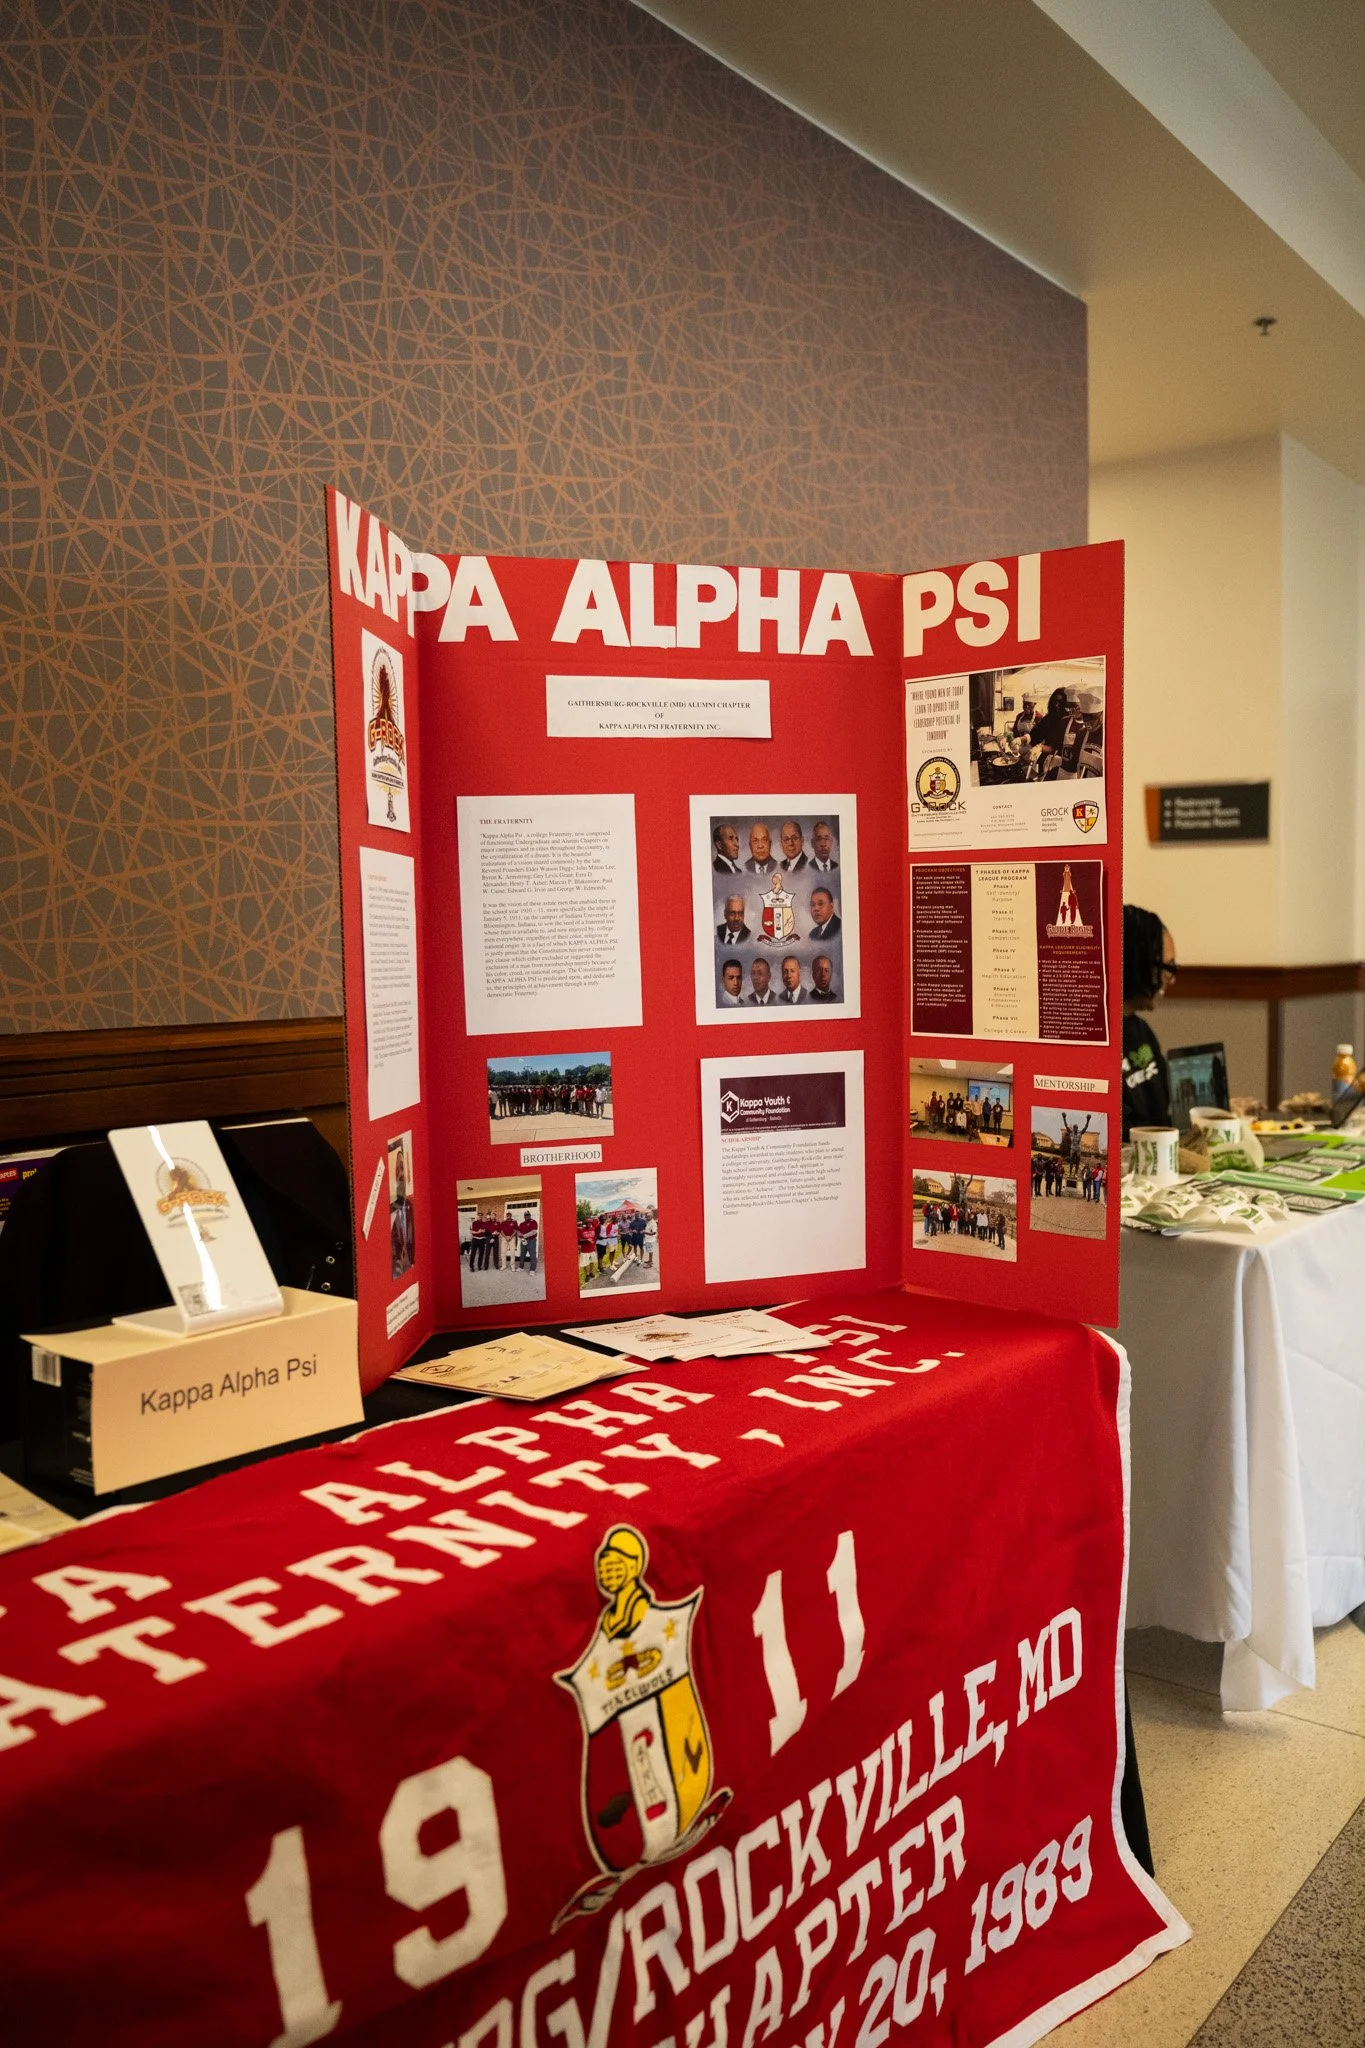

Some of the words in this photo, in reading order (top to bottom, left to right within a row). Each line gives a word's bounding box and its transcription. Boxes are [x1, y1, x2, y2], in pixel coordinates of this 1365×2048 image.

[335, 489, 519, 642] KAPPA
[552, 558, 875, 657] ALPHA
[903, 553, 1040, 657] PSI
[568, 700, 669, 708] GAITHERSBURG-ROCKVILLE
[670, 701, 687, 709] (MD)
[1040, 807, 1069, 817] GROCK
[1035, 1079, 1096, 1091] MENTORSHIP
[727, 1101, 734, 1113] K
[740, 1099, 763, 1110] Kappa
[764, 1097, 785, 1107] Youth
[740, 1108, 765, 1117] Community
[765, 1107, 791, 1115] Foundation
[523, 1151, 601, 1164] BROTHERHOOD
[141, 1382, 213, 1416] Kappa
[219, 1367, 279, 1398] Alpha
[287, 1353, 317, 1382] Psi
[750, 1346, 966, 1412] INC.
[301, 1380, 716, 1527] ALPHA
[1017, 1607, 1084, 1727] MD
[854, 1926, 947, 2048] 20,
[966, 1815, 1093, 1977] 1989
